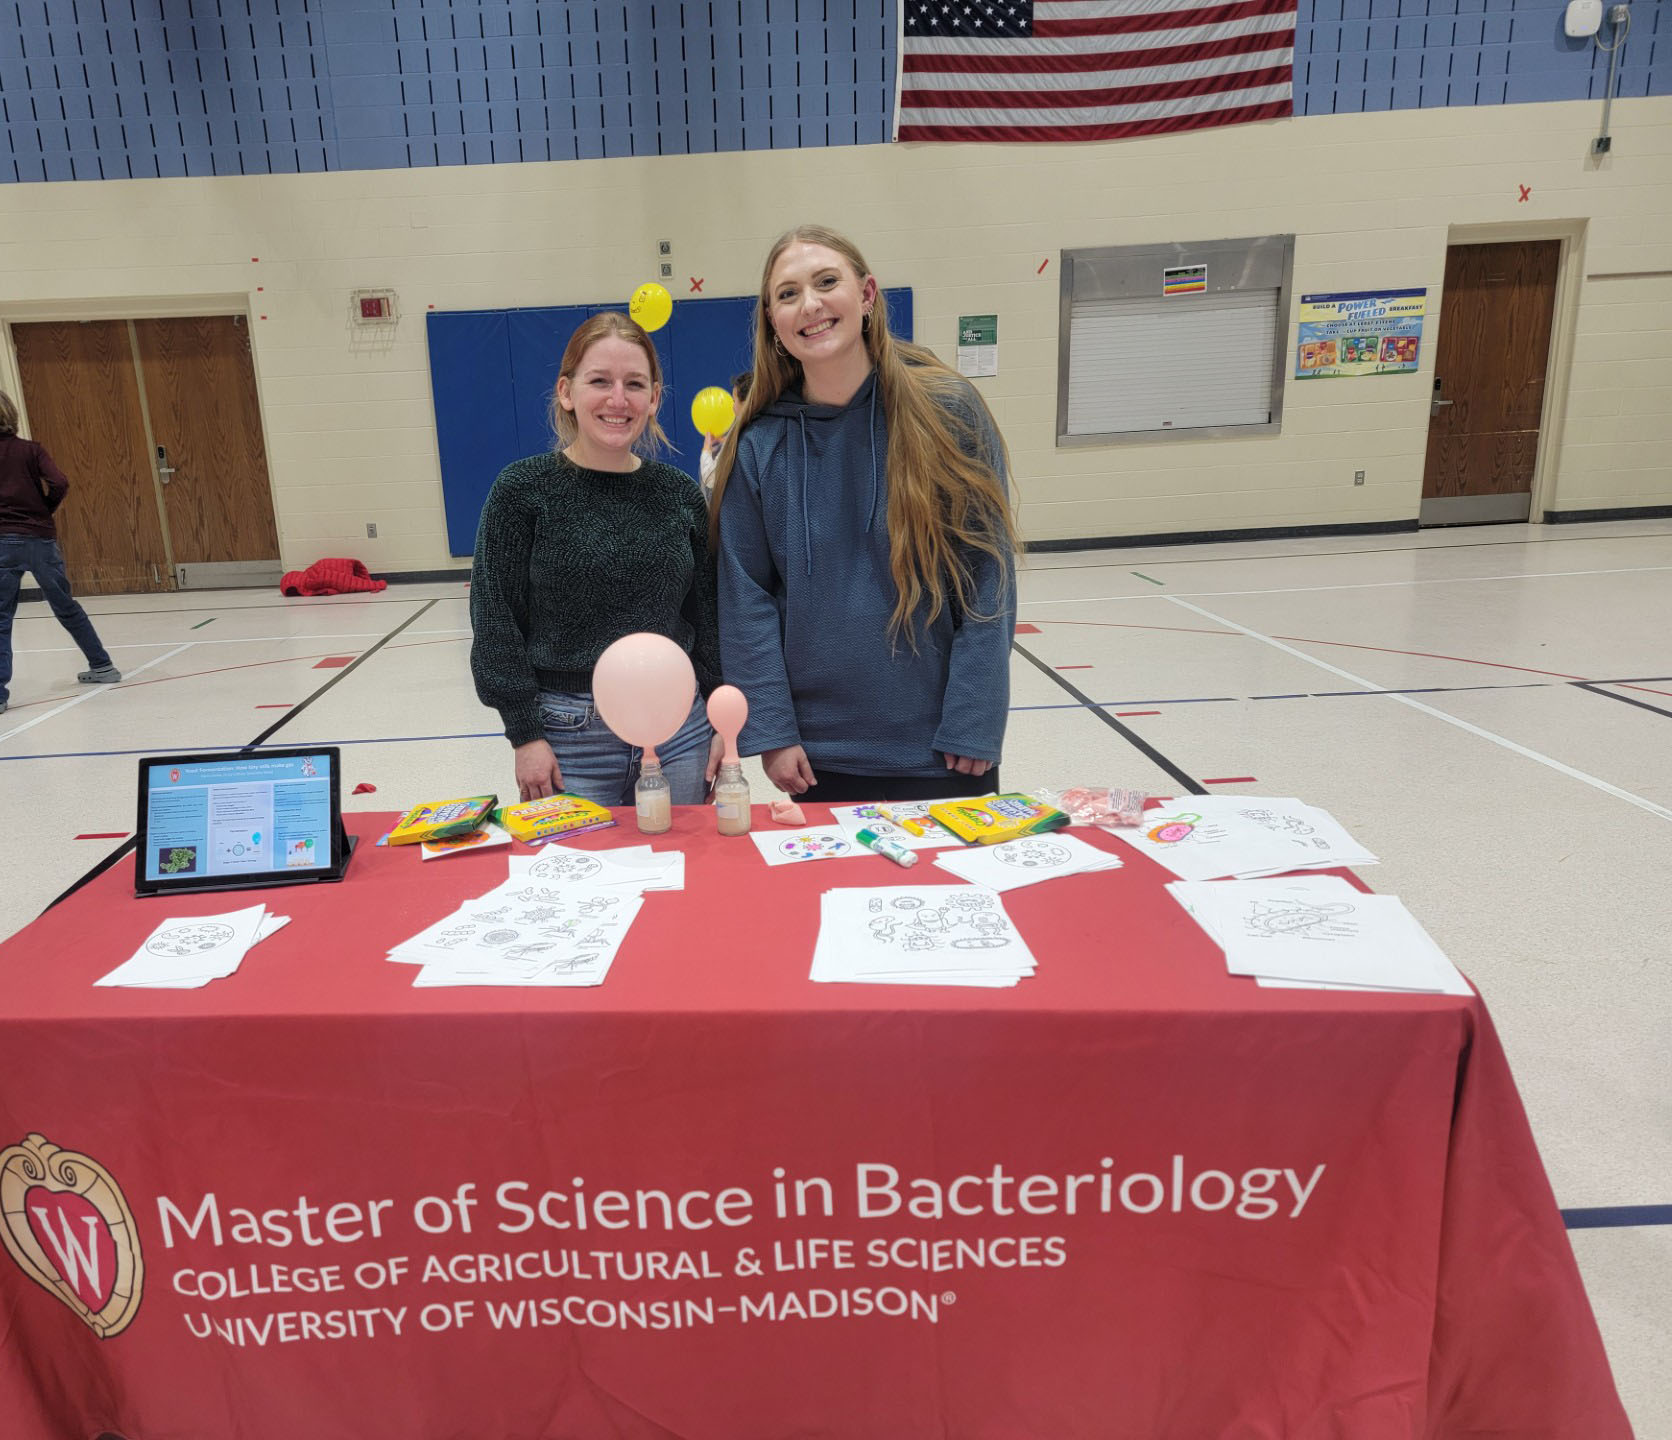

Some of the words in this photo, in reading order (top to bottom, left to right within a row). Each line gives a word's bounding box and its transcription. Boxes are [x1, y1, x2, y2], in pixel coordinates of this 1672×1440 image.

[1337, 298, 1377, 313] POWER
[1347, 307, 1387, 321] FUELED
[157, 1193, 394, 1249] Master
[414, 1184, 478, 1234] of
[496, 1177, 753, 1233] Science
[774, 1168, 833, 1219] in
[857, 1155, 1326, 1220] Bacteriology
[32, 1207, 101, 1299] W
[173, 1264, 345, 1301] COLLEGE
[355, 1257, 409, 1290] OF
[422, 1250, 722, 1285] AGRICULTURAL
[735, 1248, 764, 1277] &
[775, 1239, 856, 1272] LIFE
[868, 1237, 1067, 1273] SCIENCES
[184, 1307, 407, 1347] UNIVERSITY
[421, 1301, 474, 1332] OF
